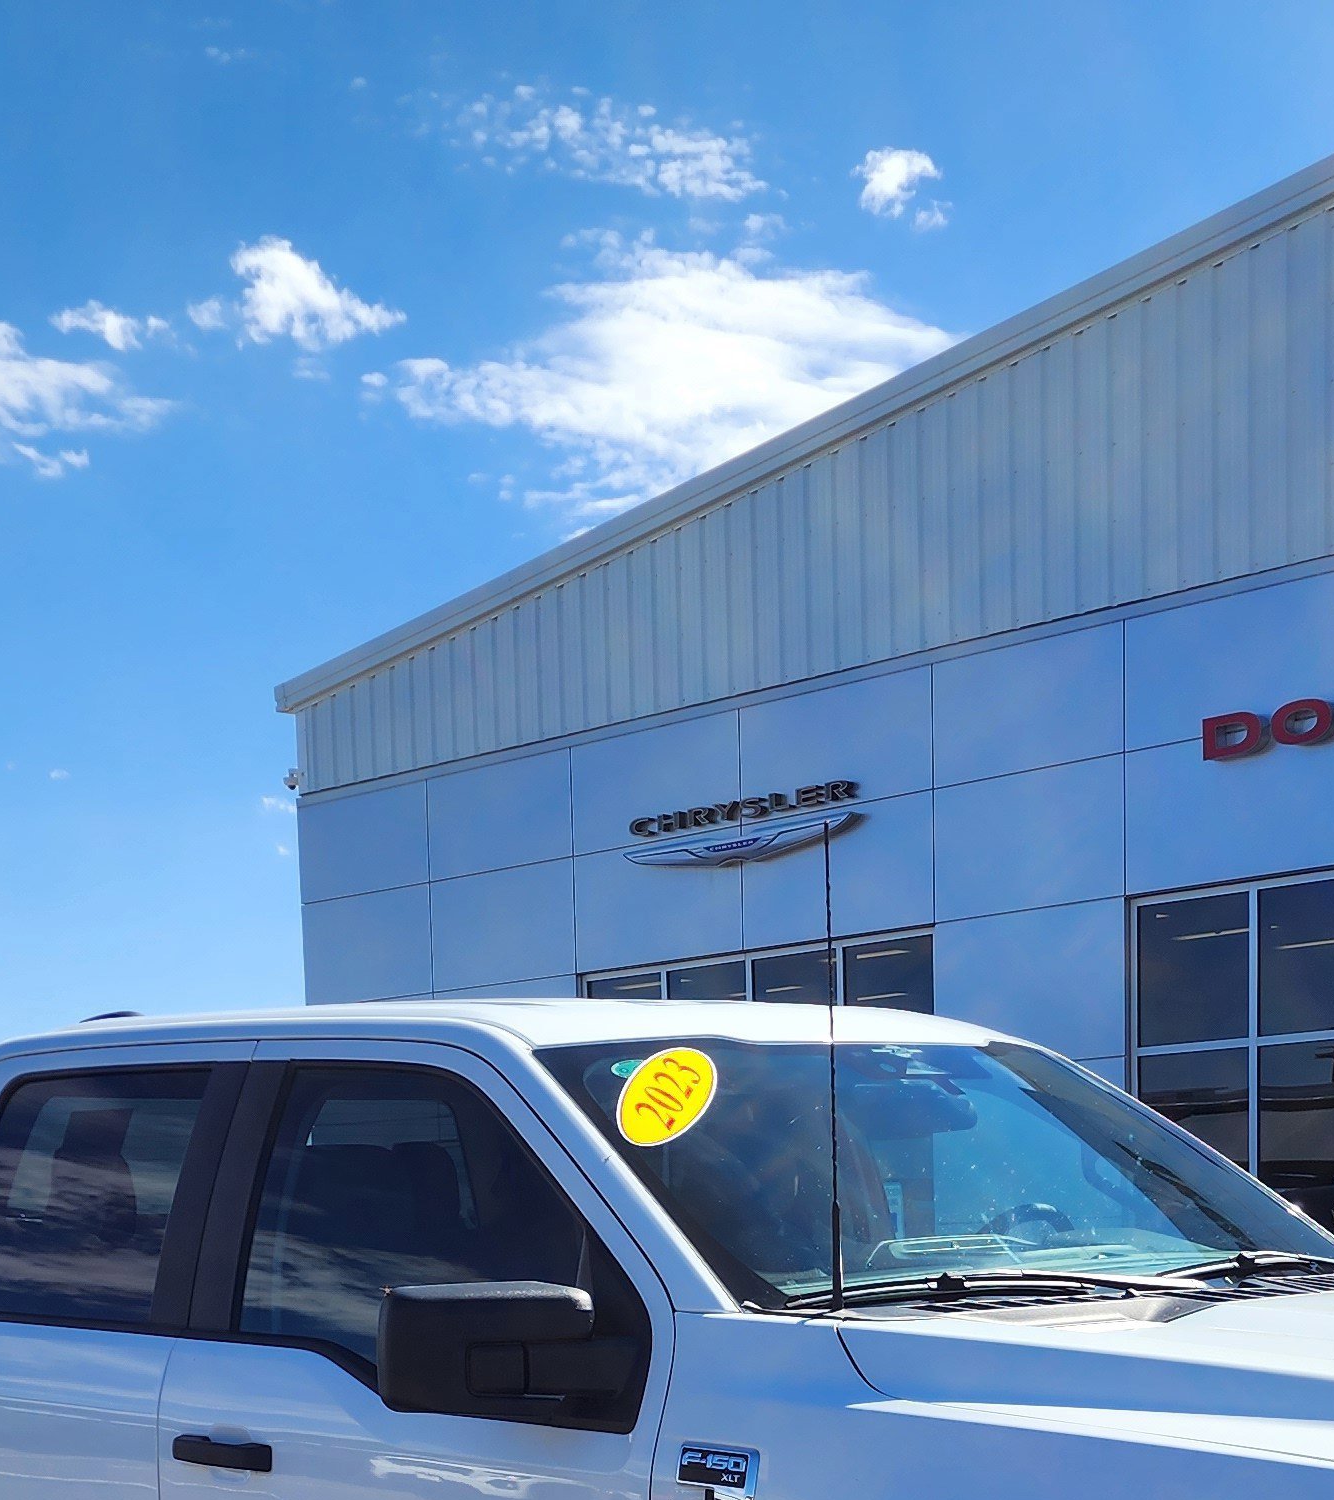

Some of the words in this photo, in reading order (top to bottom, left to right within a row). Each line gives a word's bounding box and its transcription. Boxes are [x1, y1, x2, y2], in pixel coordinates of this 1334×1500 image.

[629, 779, 857, 836] CHRYSLER
[635, 1057, 701, 1131] 2023
[681, 1451, 747, 1473] F-150
[720, 1472, 741, 1484] XLT
